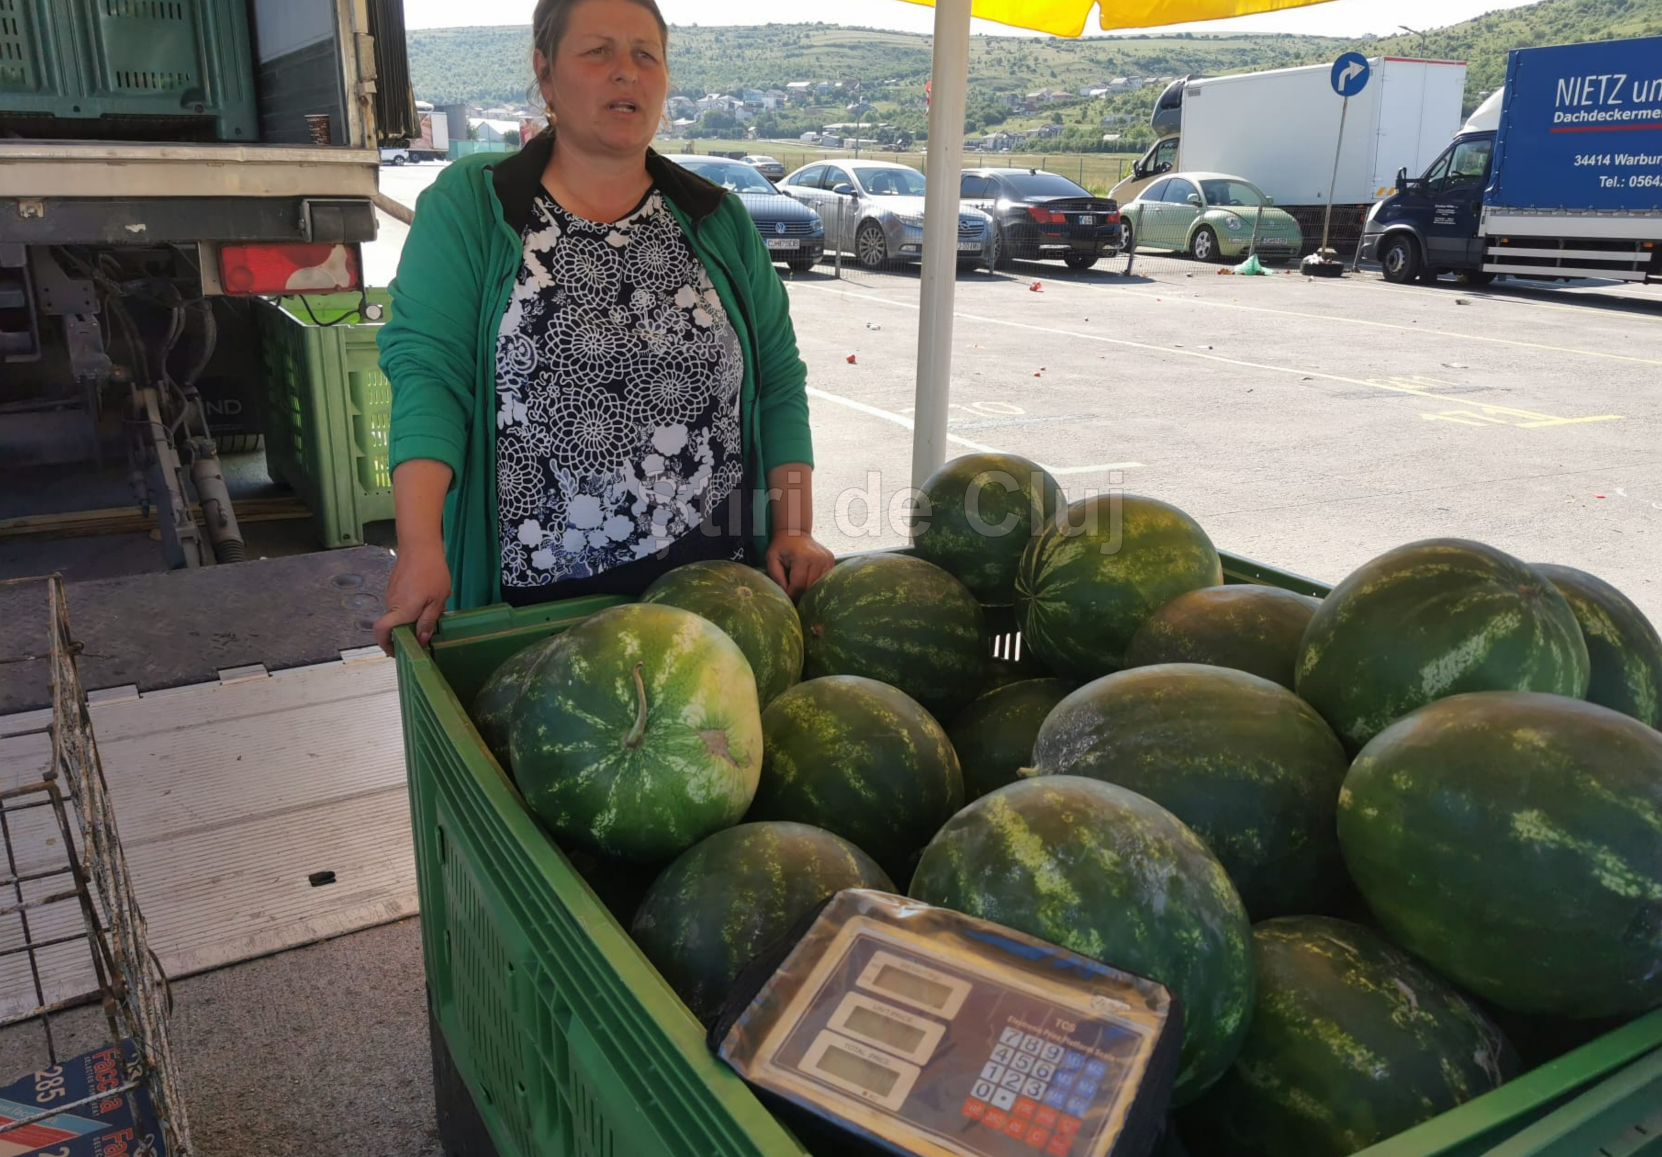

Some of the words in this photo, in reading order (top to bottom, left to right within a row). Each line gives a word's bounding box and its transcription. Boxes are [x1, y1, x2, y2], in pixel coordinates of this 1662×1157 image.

[1555, 74, 1627, 107] NIETZ
[1632, 79, 1662, 103] un
[1574, 154, 1611, 166] 34414
[1614, 153, 1662, 167] Warbur
[1599, 175, 1626, 188] Tel.:
[1005, 1030, 1018, 1045] 7
[1025, 1038, 1038, 1053] 8
[1045, 1046, 1060, 1060] 9
[995, 1048, 1008, 1062] 4
[1015, 1054, 1029, 1070] 5
[1036, 1063, 1049, 1079] 6
[35, 1065, 65, 1103] 285
[92, 1047, 123, 1114] Facca
[976, 1083, 991, 1099] 0
[987, 1065, 998, 1079] 1
[1005, 1073, 1020, 1089] 2
[1027, 1081, 1042, 1097] 3
